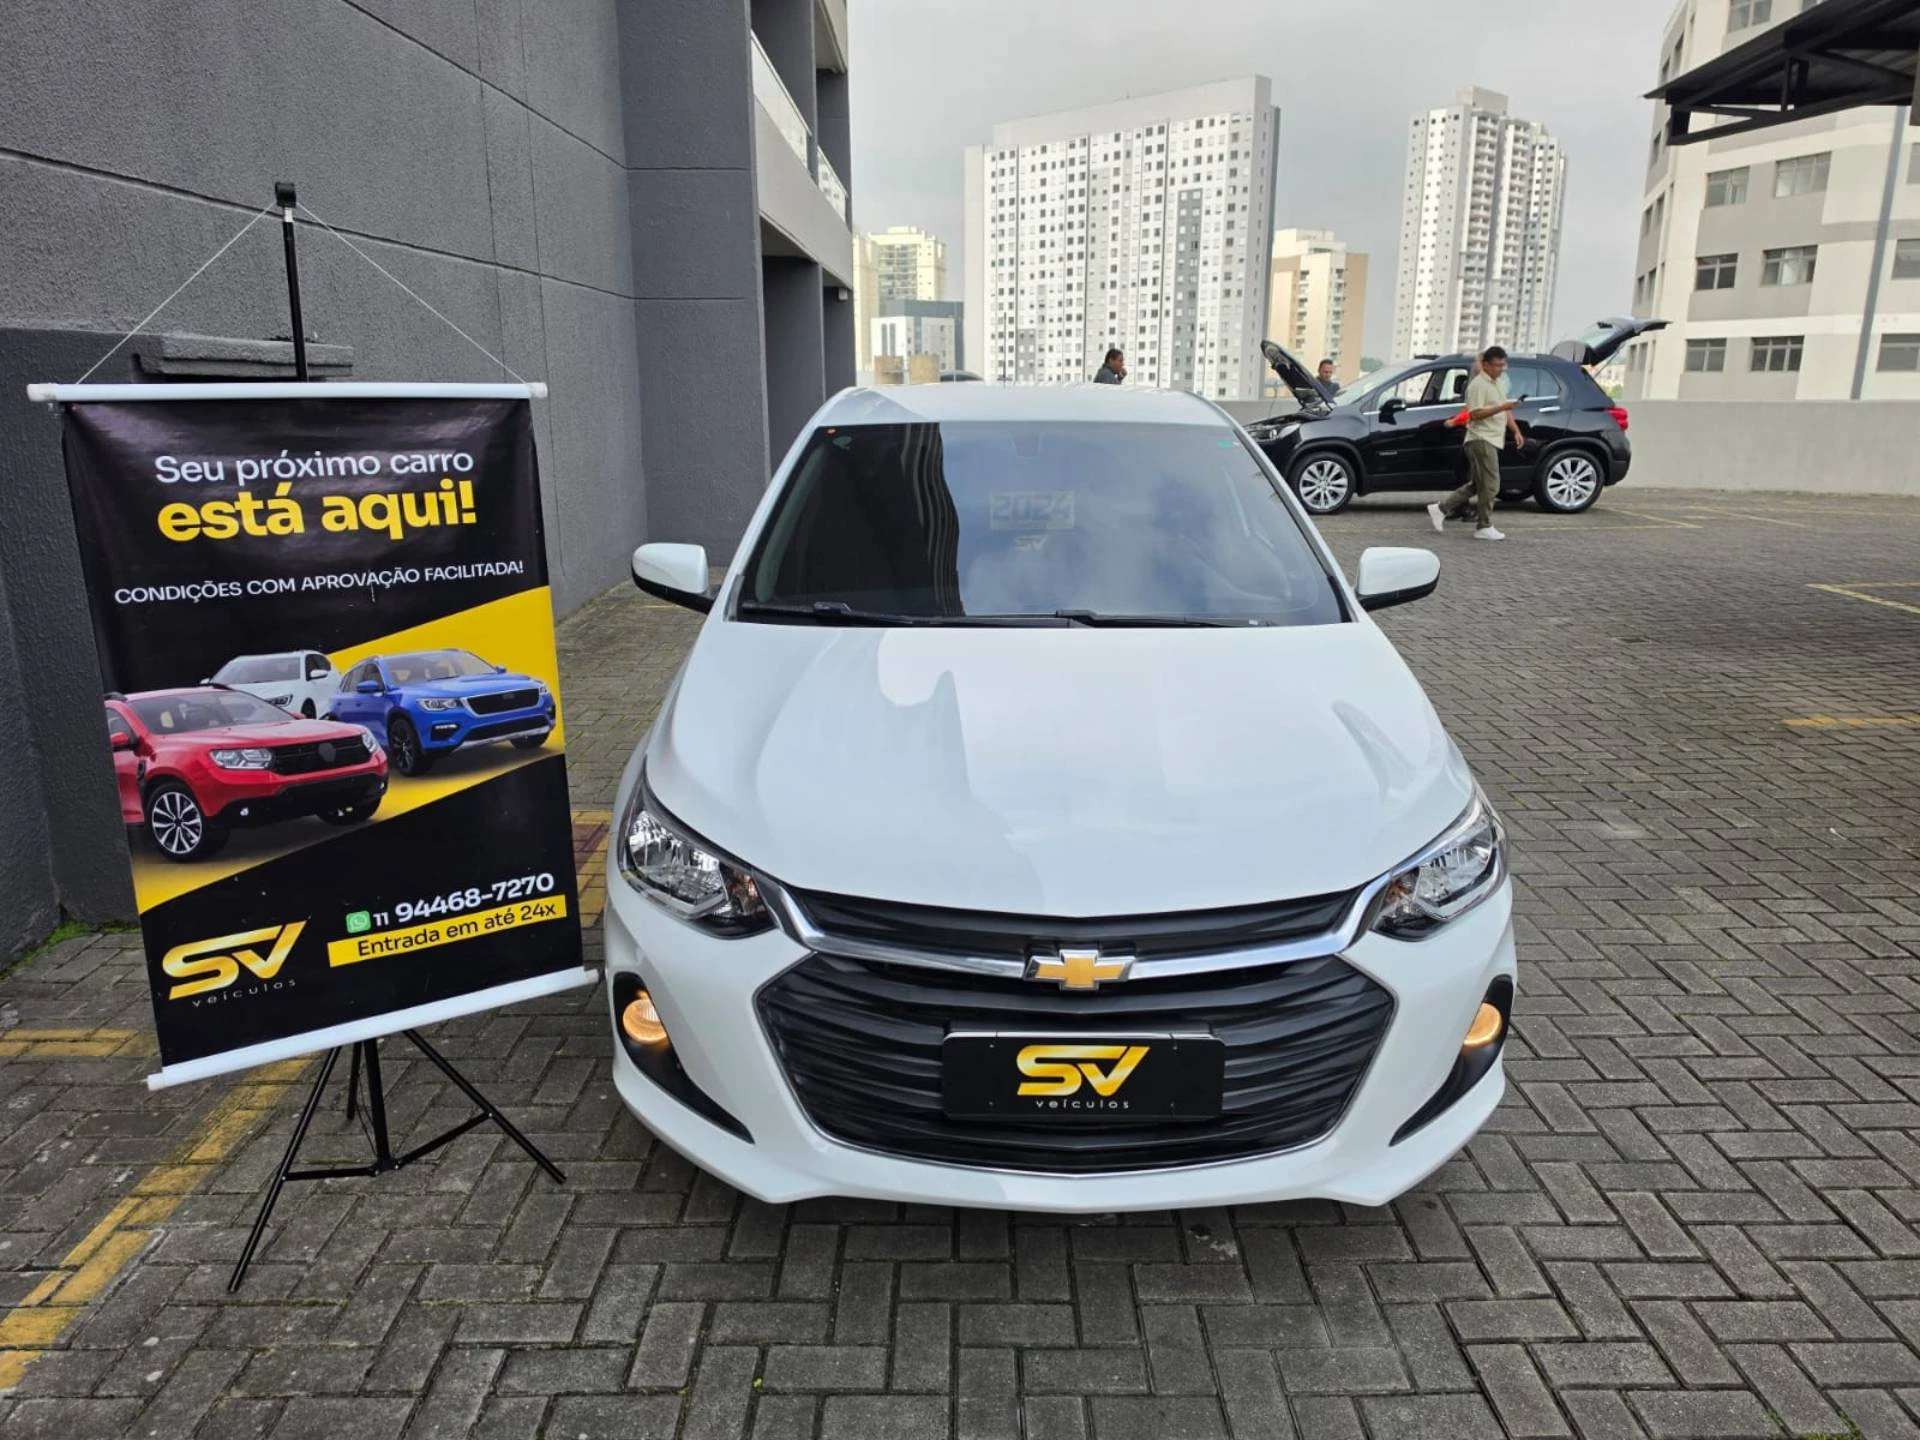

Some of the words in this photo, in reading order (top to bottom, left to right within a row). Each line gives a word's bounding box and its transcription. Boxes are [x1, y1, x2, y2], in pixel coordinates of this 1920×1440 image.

[155, 455, 225, 484] Seu
[236, 450, 381, 486] próximo
[390, 450, 475, 474] carro
[157, 482, 304, 542] está
[321, 478, 477, 540] aqui!
[114, 580, 243, 605] CONDIÇÕES
[246, 577, 296, 594] COM
[301, 566, 421, 591] APROVAÇÃO
[424, 560, 524, 581] FACILITADA!
[373, 912, 390, 928] 11
[395, 872, 556, 924] 94468-7270
[357, 929, 442, 957] Entrada
[446, 919, 480, 939] em
[483, 908, 516, 932] até
[520, 902, 557, 922] 24x
[162, 919, 308, 1000] SV
[1015, 1044, 1151, 1097] SV
